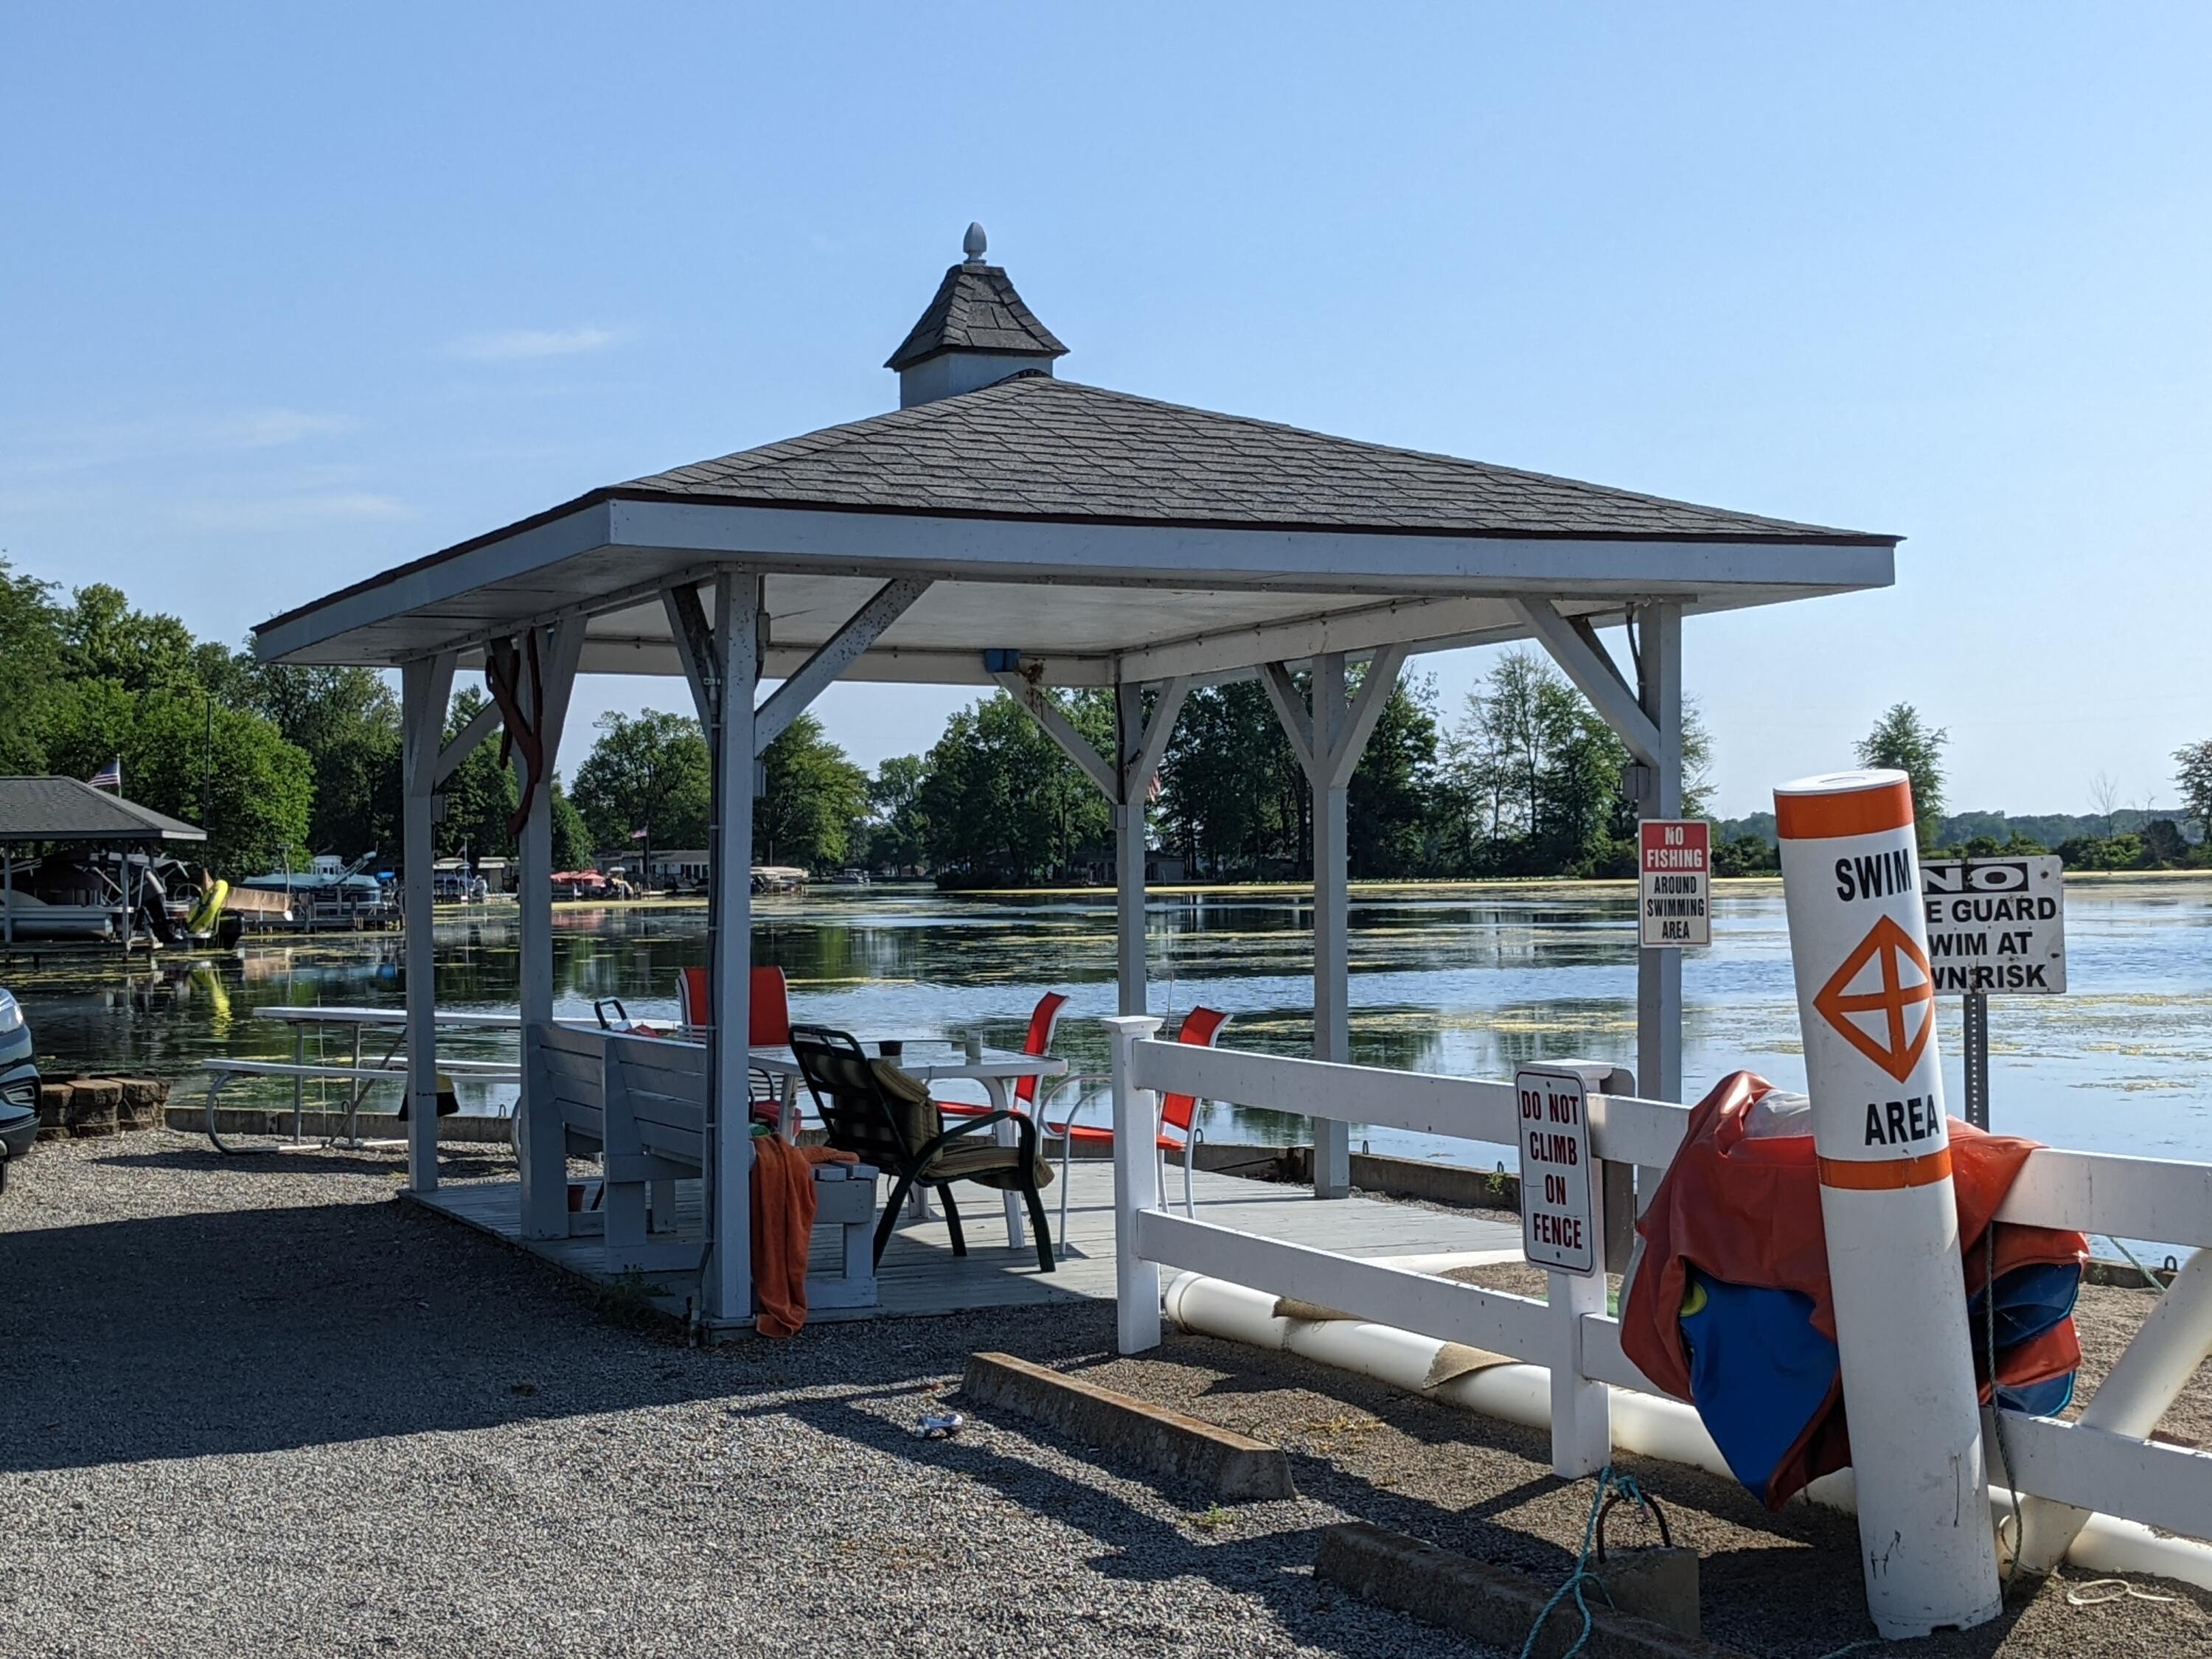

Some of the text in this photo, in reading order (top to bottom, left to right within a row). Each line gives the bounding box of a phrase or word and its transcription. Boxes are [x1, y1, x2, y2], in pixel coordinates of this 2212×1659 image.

[1665, 827, 1683, 845] NO
[1646, 849, 1703, 868] FISHING
[1654, 876, 1697, 894] AROUND
[1835, 848, 1912, 902] SWIM
[1919, 866, 2025, 892] NO
[1646, 898, 1705, 917] SWIMMING
[1951, 897, 2056, 923] GUARD
[1661, 921, 1690, 940] AREA
[1928, 931, 2034, 957] WIM AT
[1930, 964, 2048, 990] WN RISK
[1521, 1090, 1579, 1125] DO NOT
[1865, 1093, 1940, 1146] AREA
[1529, 1131, 1578, 1166] CLIMB
[1545, 1173, 1566, 1206] ON
[1533, 1212, 1583, 1250] FENCE
